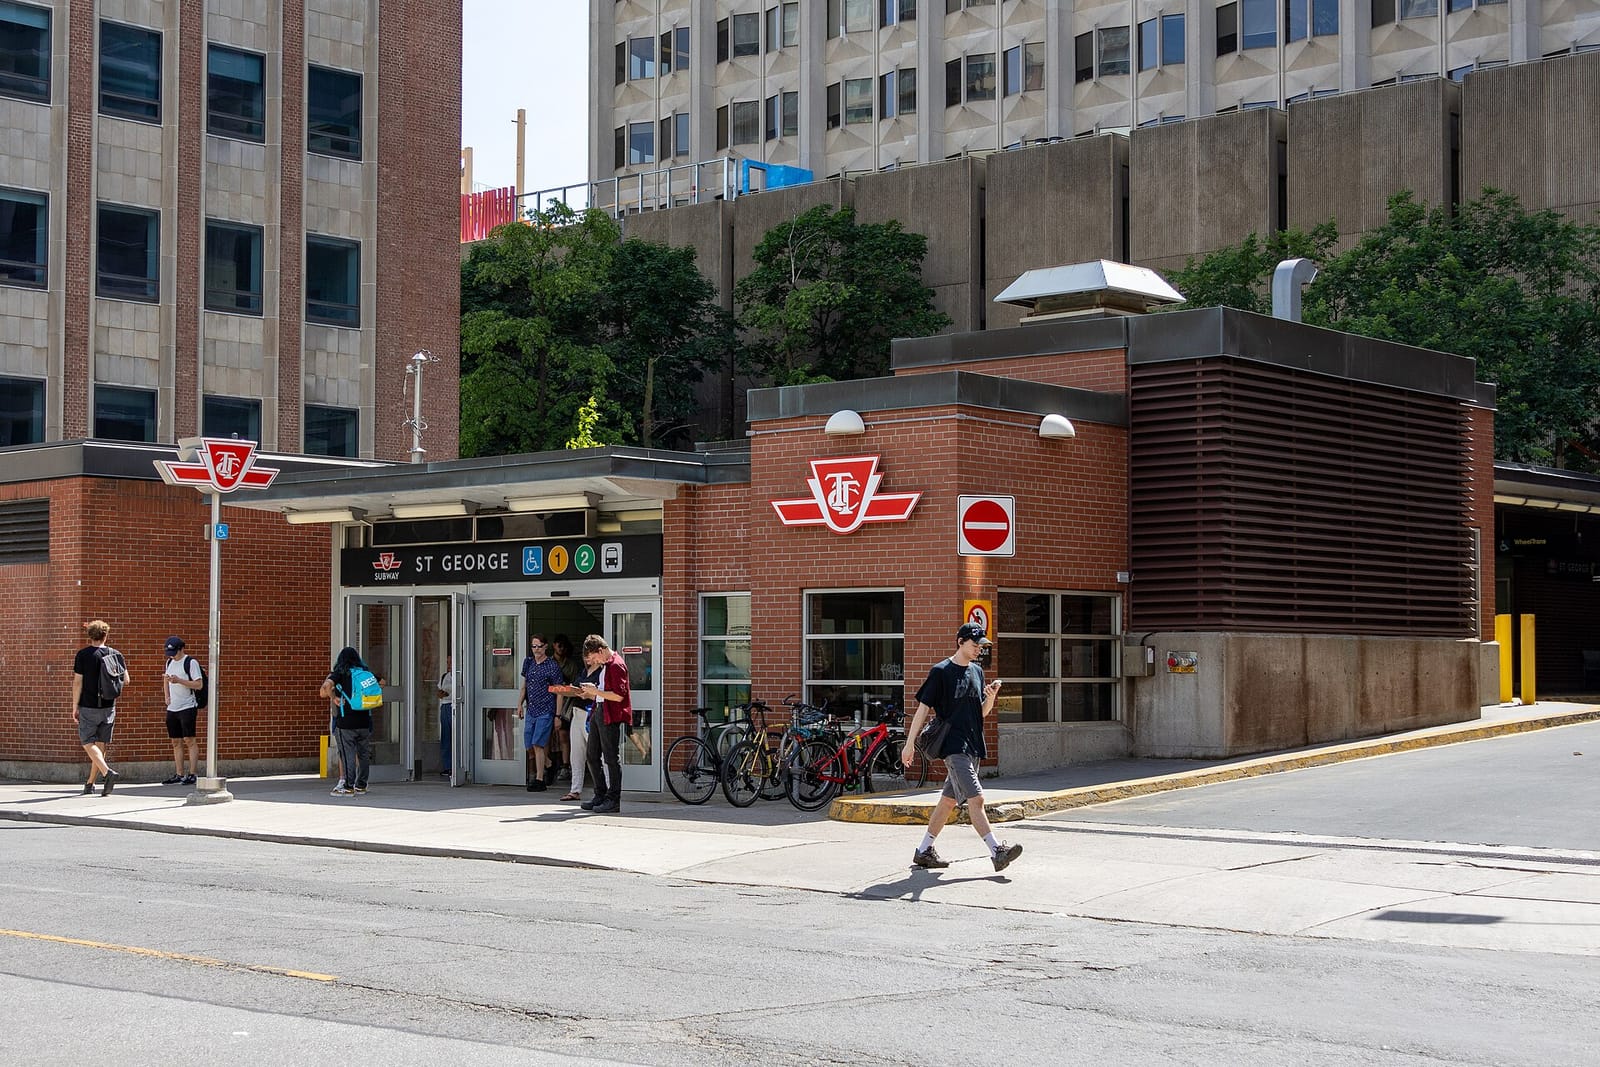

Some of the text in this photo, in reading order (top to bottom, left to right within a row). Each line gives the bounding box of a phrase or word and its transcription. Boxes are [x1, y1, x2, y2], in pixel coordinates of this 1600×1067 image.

[825, 472, 861, 515] TTC
[416, 551, 589, 572] ST GEORGE 1 2
[374, 572, 400, 581] SUBWAY
